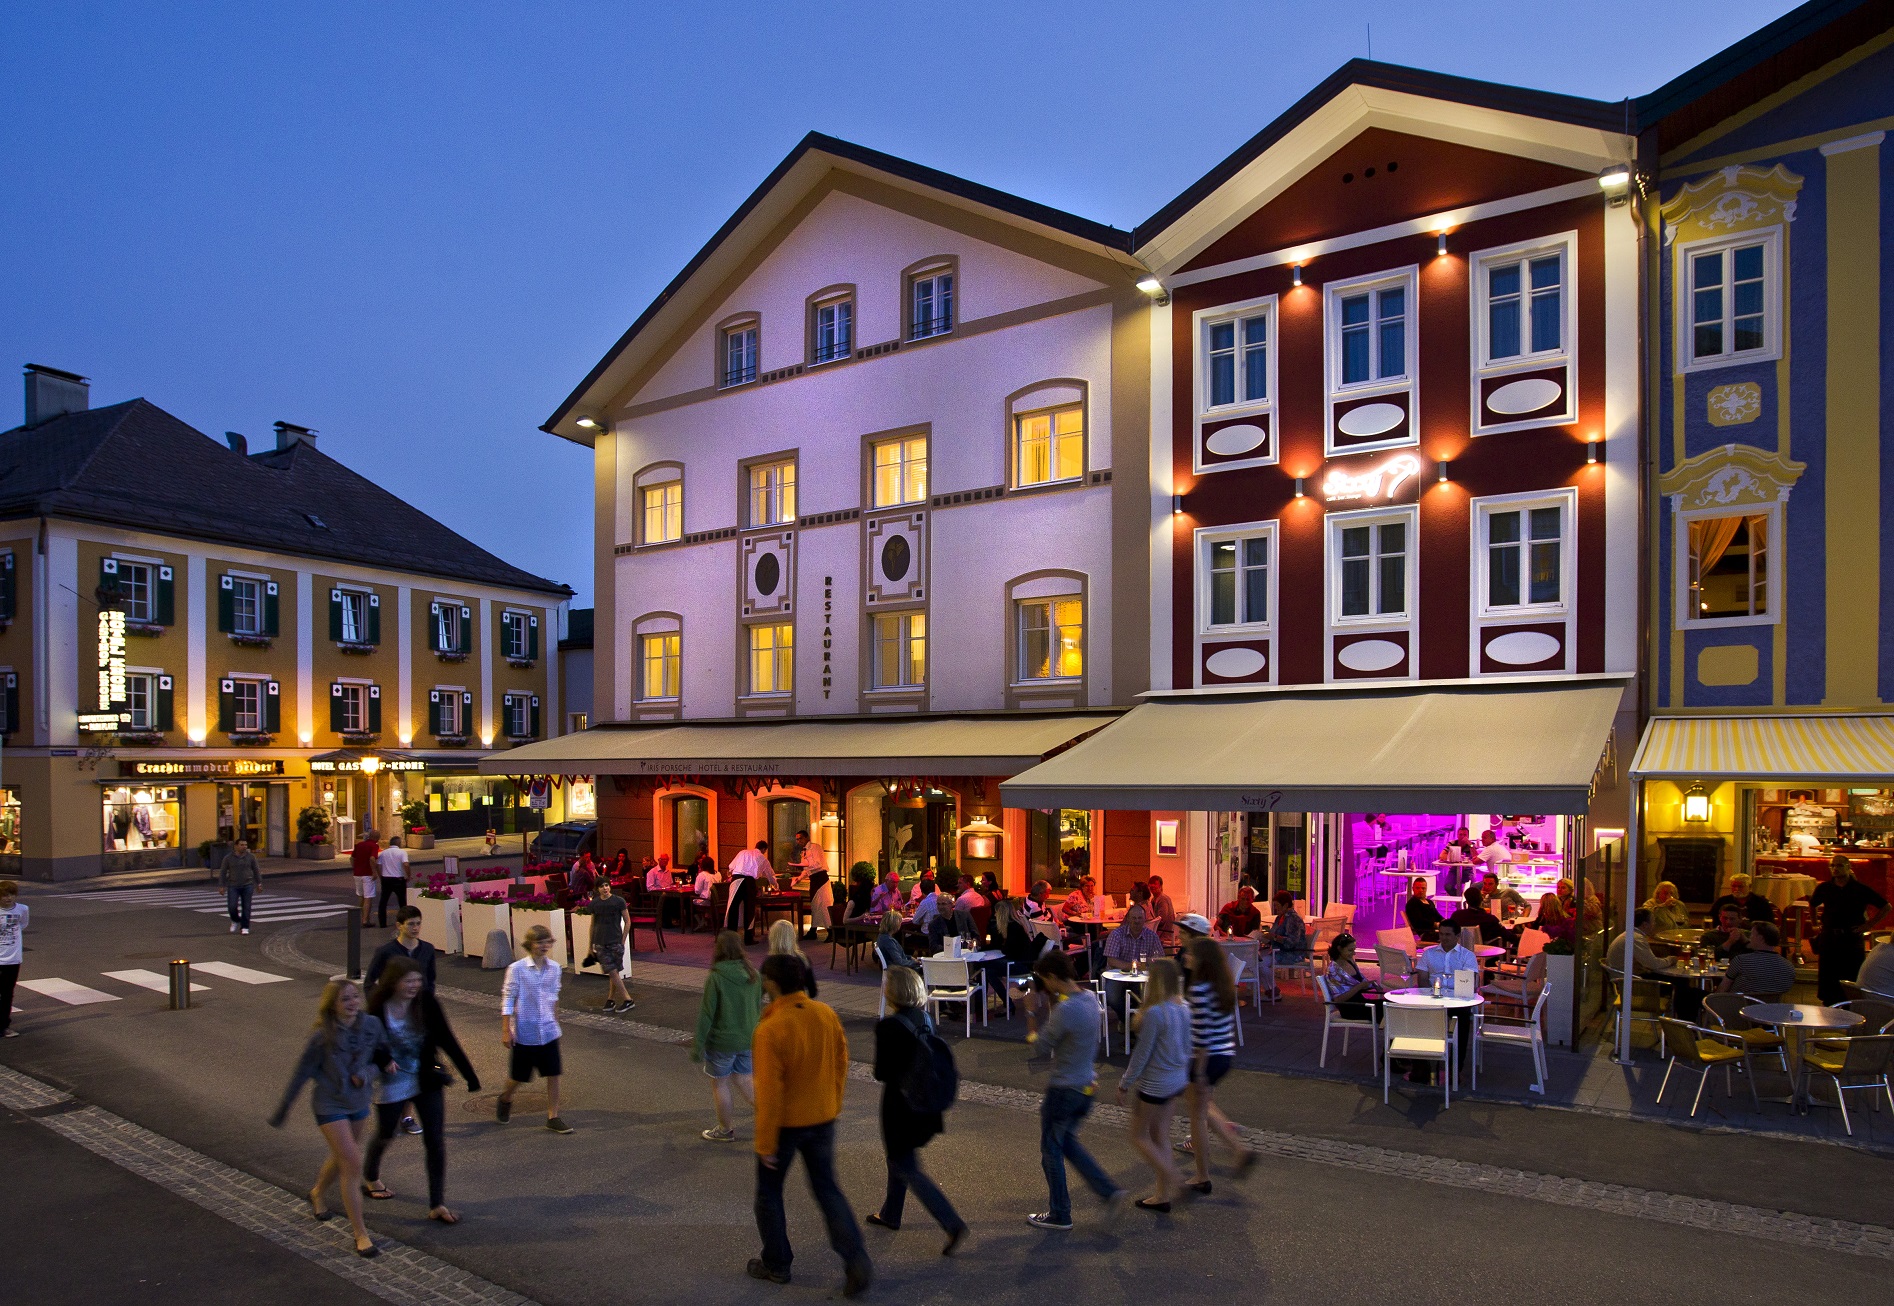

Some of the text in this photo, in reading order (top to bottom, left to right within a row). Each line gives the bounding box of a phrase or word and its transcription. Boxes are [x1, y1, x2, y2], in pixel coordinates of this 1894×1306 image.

[823, 576, 832, 700] RESTAURANT
[109, 611, 126, 702] HOTEL KRONE
[311, 762, 336, 771] HOTEL
[647, 764, 780, 772] IRIS PORSCHE HOTEL & RESTAURANT
[1241, 795, 1267, 809] Sixty
